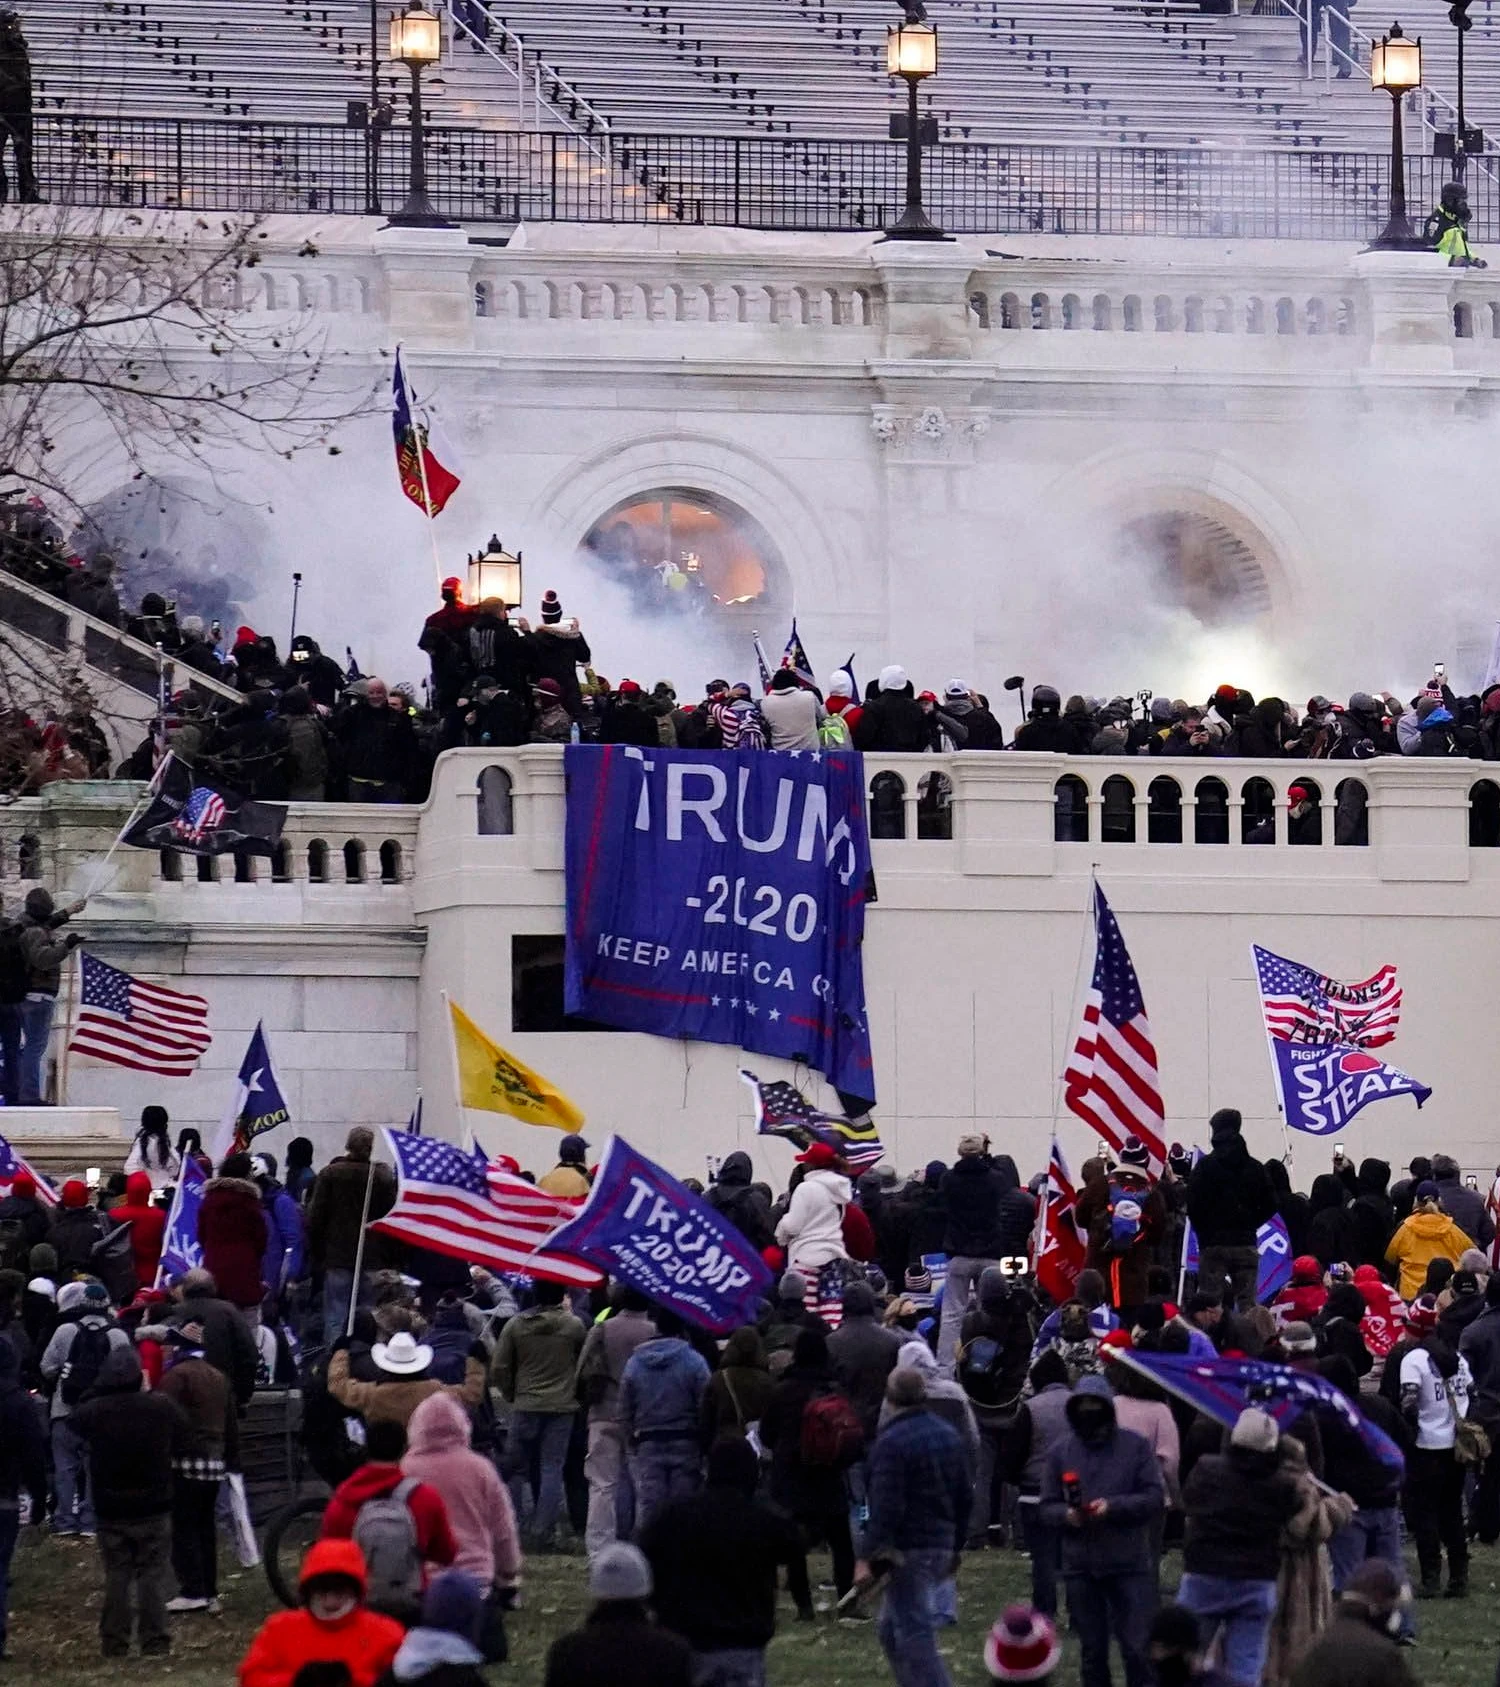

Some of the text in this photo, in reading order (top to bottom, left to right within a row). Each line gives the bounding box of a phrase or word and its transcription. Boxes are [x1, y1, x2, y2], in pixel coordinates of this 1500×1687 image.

[596, 933, 670, 969] KEEP
[680, 948, 794, 992] AMERCA
[1291, 1048, 1327, 1061] FIGHT
[623, 1177, 752, 1294] TRUMP
